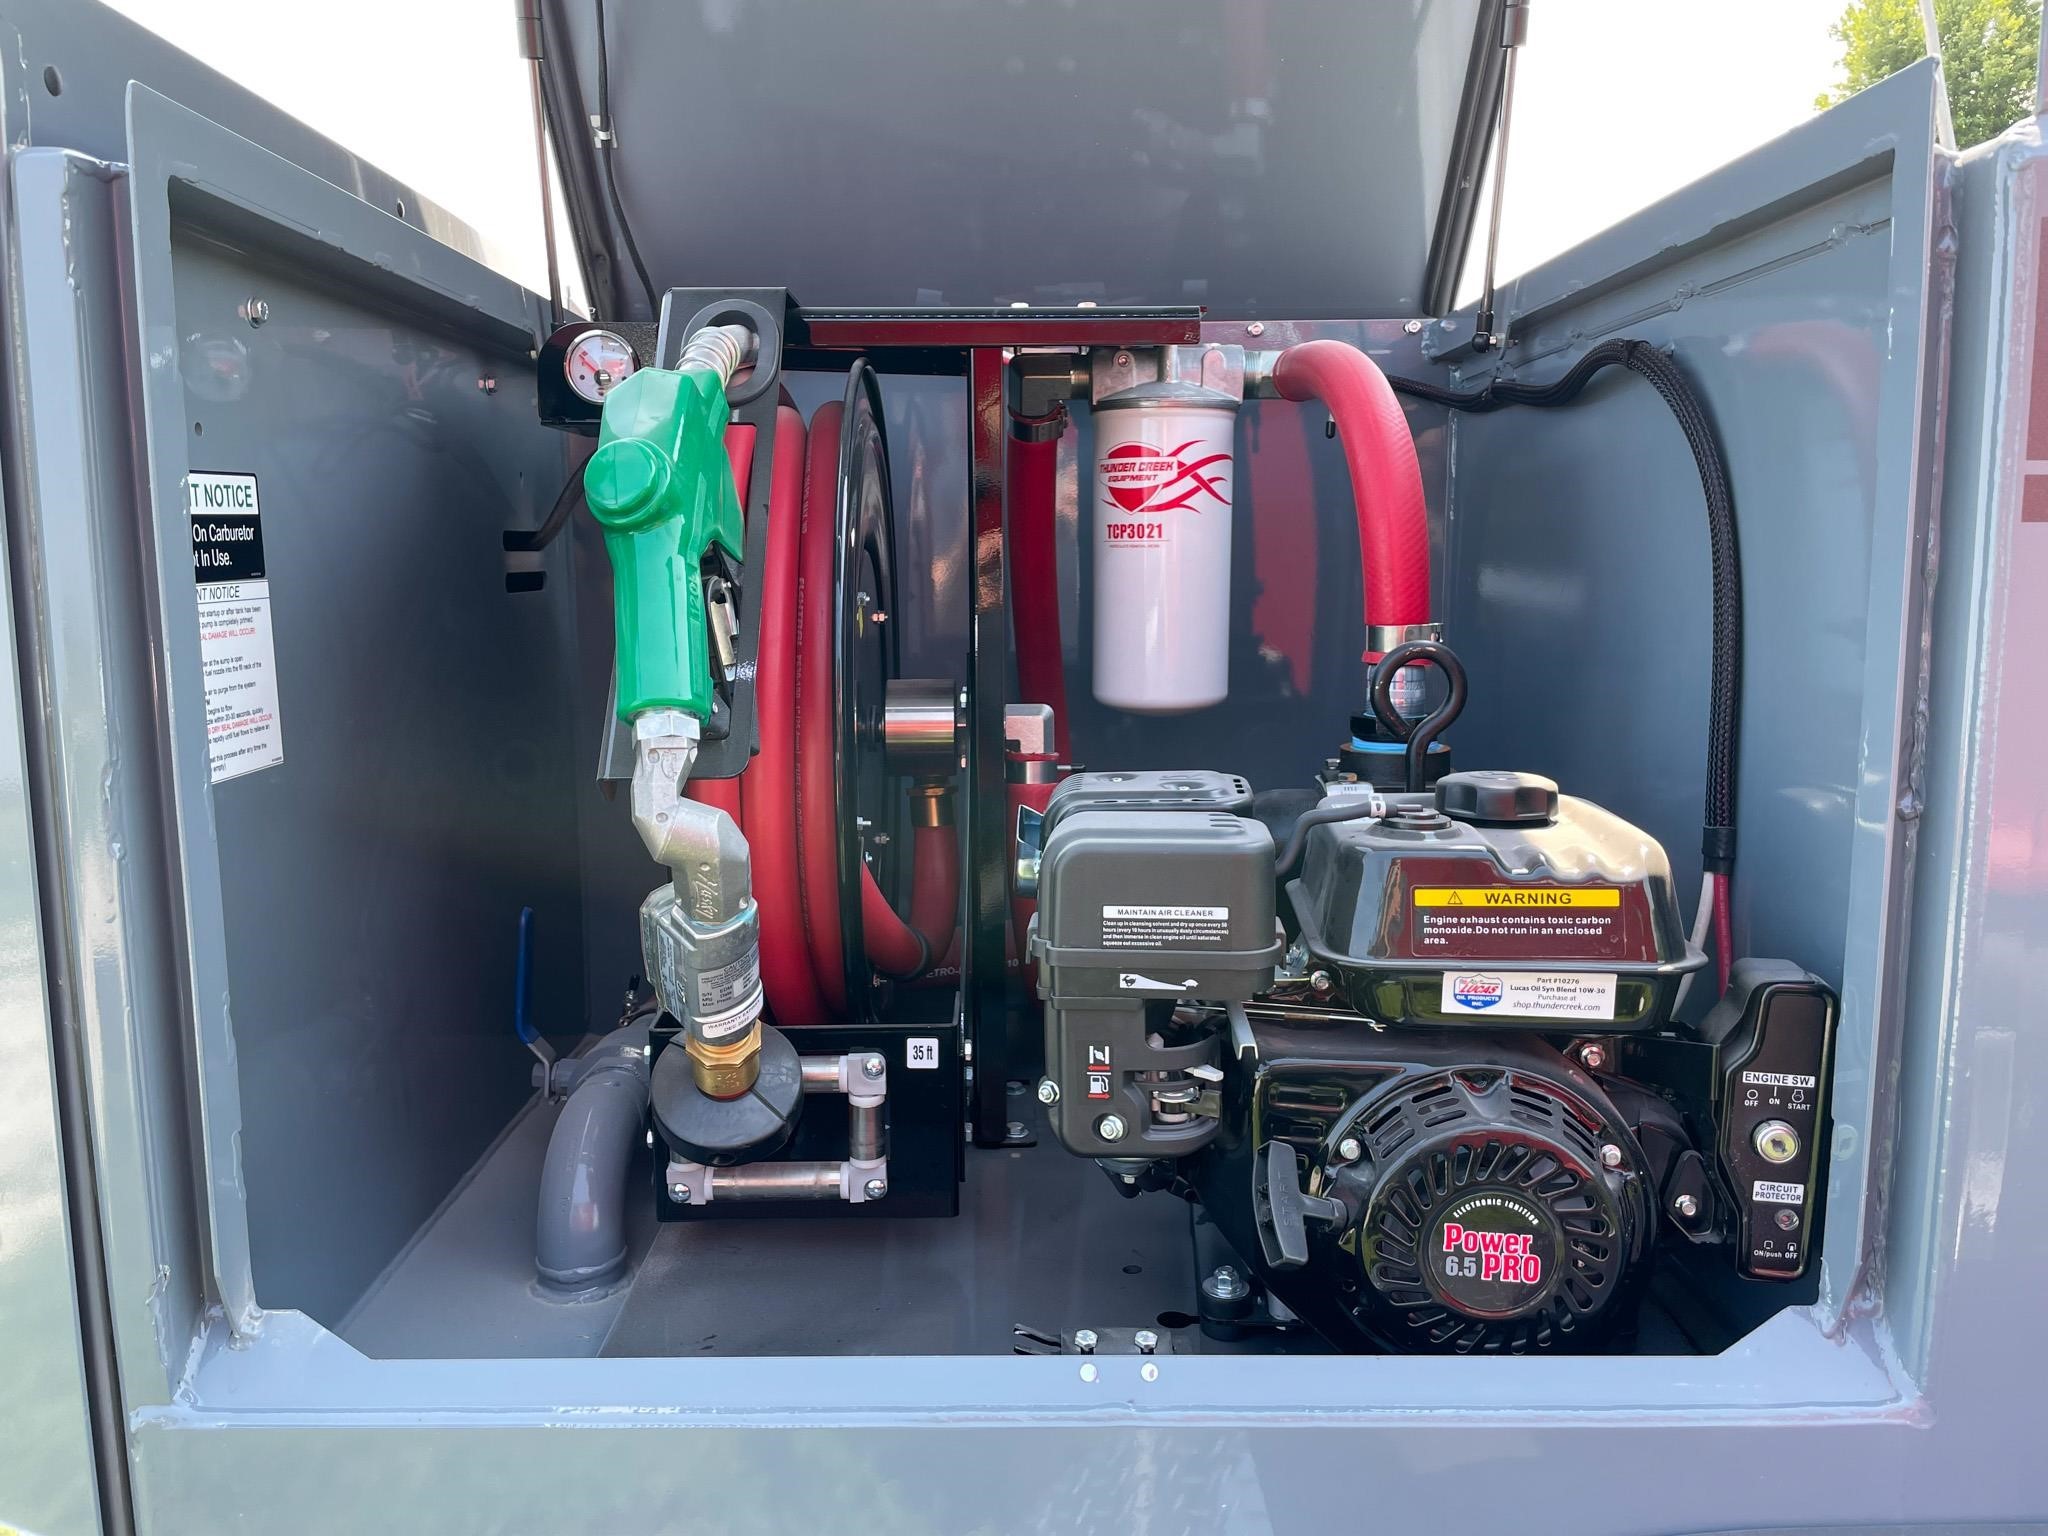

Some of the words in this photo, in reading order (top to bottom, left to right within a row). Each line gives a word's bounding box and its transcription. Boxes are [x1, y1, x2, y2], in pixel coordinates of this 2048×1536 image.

[1100, 462, 1135, 474] THUNDER
[1138, 462, 1174, 472] CREEK
[1108, 474, 1158, 483] EQUIPMENT
[204, 484, 252, 507] NOTICE
[193, 524, 207, 542] On
[209, 524, 254, 541] Carburetor
[1107, 524, 1162, 539] TCP3021
[201, 549, 210, 566] In
[212, 549, 232, 566] Use.
[210, 586, 240, 600] NOTICE
[1485, 892, 1572, 904] WARNING
[1424, 916, 1457, 925] Engine
[1460, 916, 1499, 924] exhaust
[1502, 916, 1545, 924] contains
[1548, 916, 1573, 924] toxic
[1575, 916, 1611, 924] carbon
[1424, 926, 1489, 934] monoxide.Do
[1492, 926, 1508, 934] not
[1530, 926, 1538, 934] in
[1556, 926, 1602, 934] enclosed
[1459, 981, 1499, 994] LUCAS
[1542, 986, 1555, 994] Syn
[1513, 1000, 1600, 1011] shop.thundercreek.com
[913, 1045, 924, 1060] 35
[927, 1045, 933, 1060] ft
[1745, 1073, 1788, 1084] ENGINE
[1792, 1076, 1813, 1086] SW.
[1788, 1103, 1811, 1111] START
[1759, 1184, 1798, 1193] CIRCUIT
[1755, 1191, 1802, 1202] PROTECTOR
[1453, 1199, 1502, 1218] ELECTRONIC
[1504, 1200, 1539, 1225] IGNITION
[1443, 1222, 1533, 1256] Power
[1754, 1250, 1782, 1258] ON/push
[1445, 1256, 1477, 1277] 6.5
[1481, 1253, 1542, 1284] PRO
